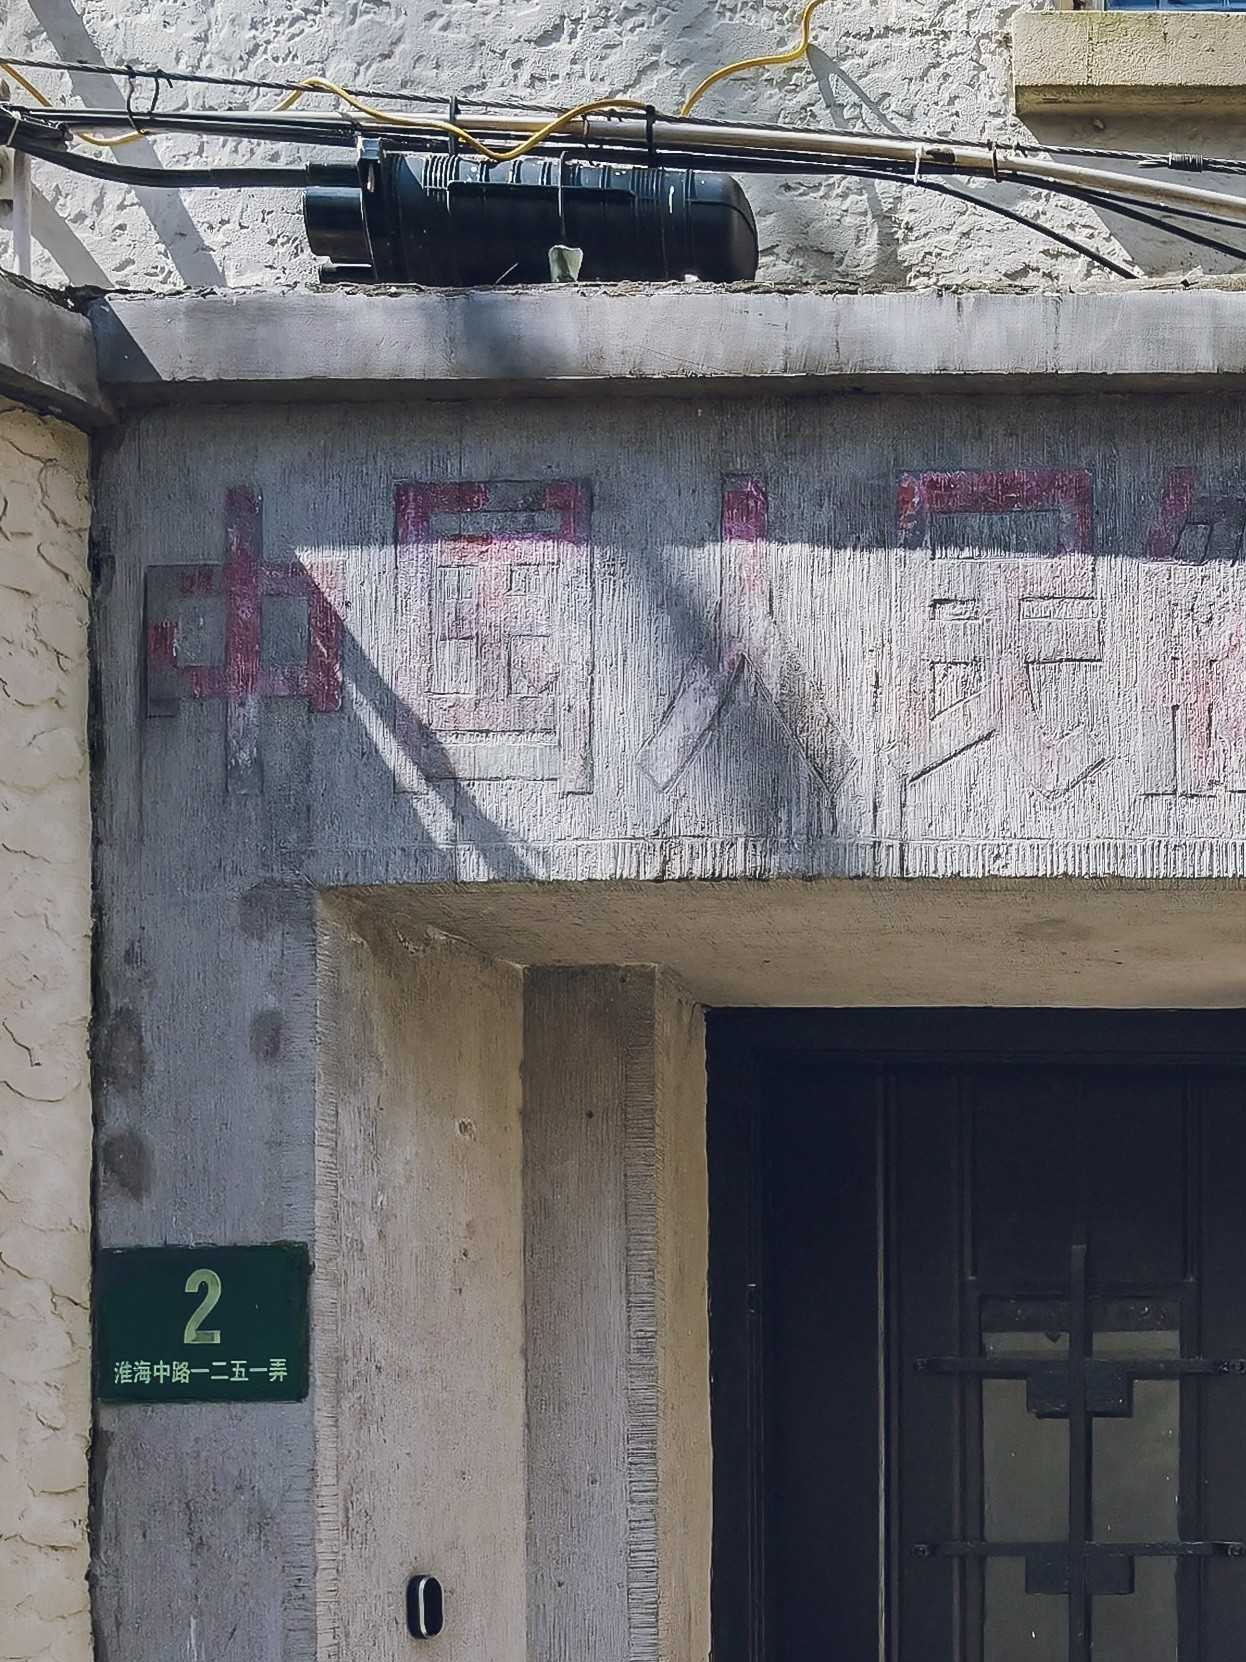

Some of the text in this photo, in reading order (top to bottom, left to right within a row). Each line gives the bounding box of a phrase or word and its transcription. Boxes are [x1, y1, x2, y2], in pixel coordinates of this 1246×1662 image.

[184, 1268, 222, 1345] 2
[114, 1358, 288, 1384] 淮海中路一二五一弄
